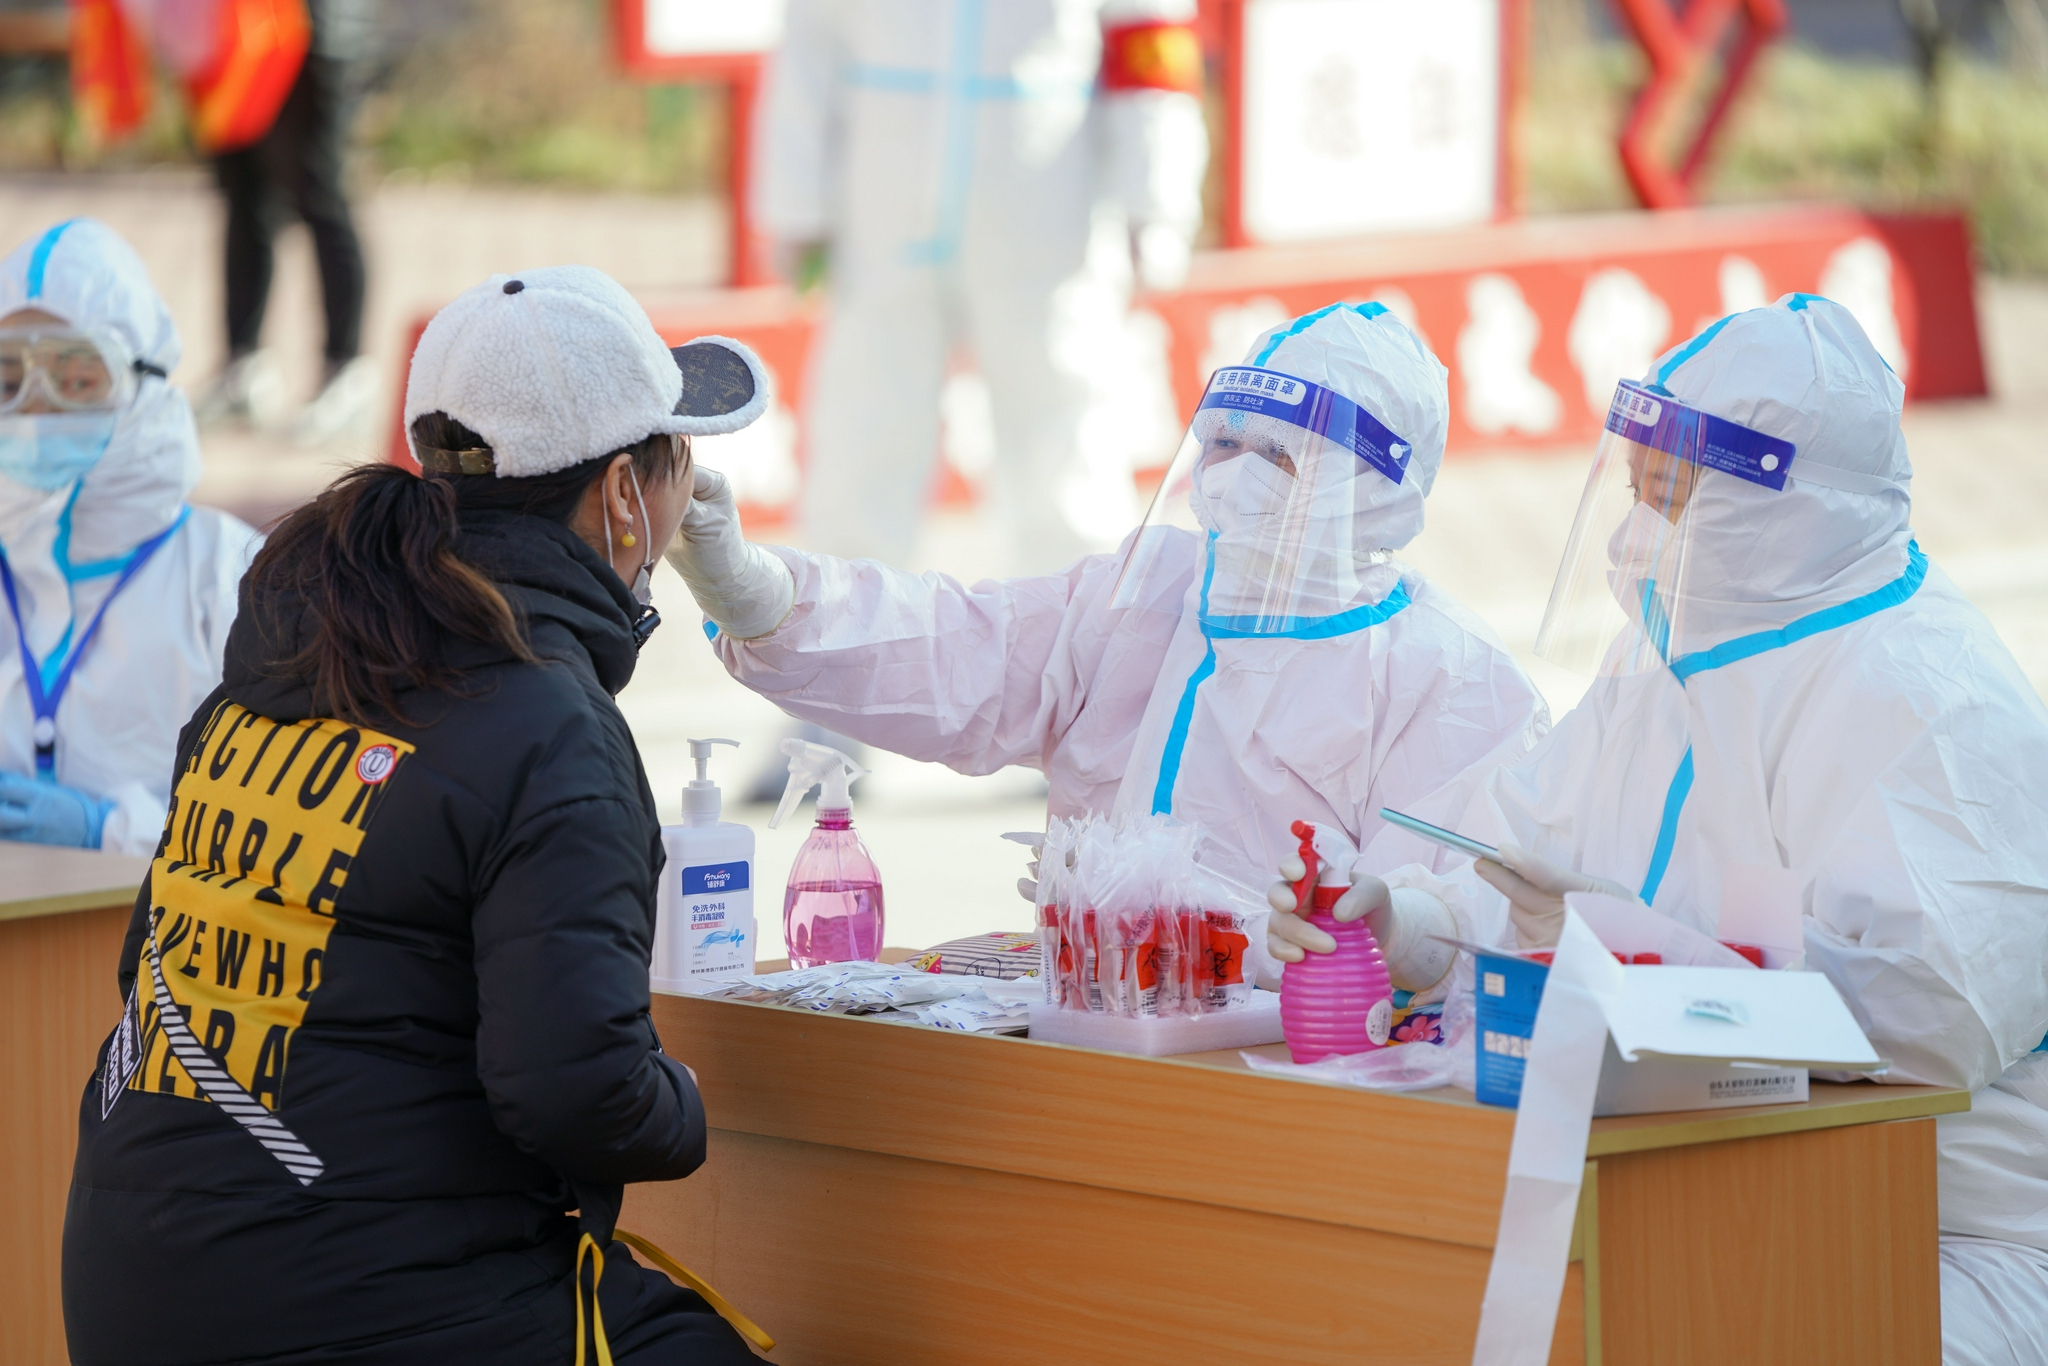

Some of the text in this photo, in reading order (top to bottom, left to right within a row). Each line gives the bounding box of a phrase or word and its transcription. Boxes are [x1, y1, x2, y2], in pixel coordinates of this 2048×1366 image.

[1216, 371, 1297, 396] 医用隔离面罩
[1239, 386, 1260, 394] isolation
[692, 902, 726, 914] 免洗外科
[691, 911, 726, 923] 手消毒凝胶
